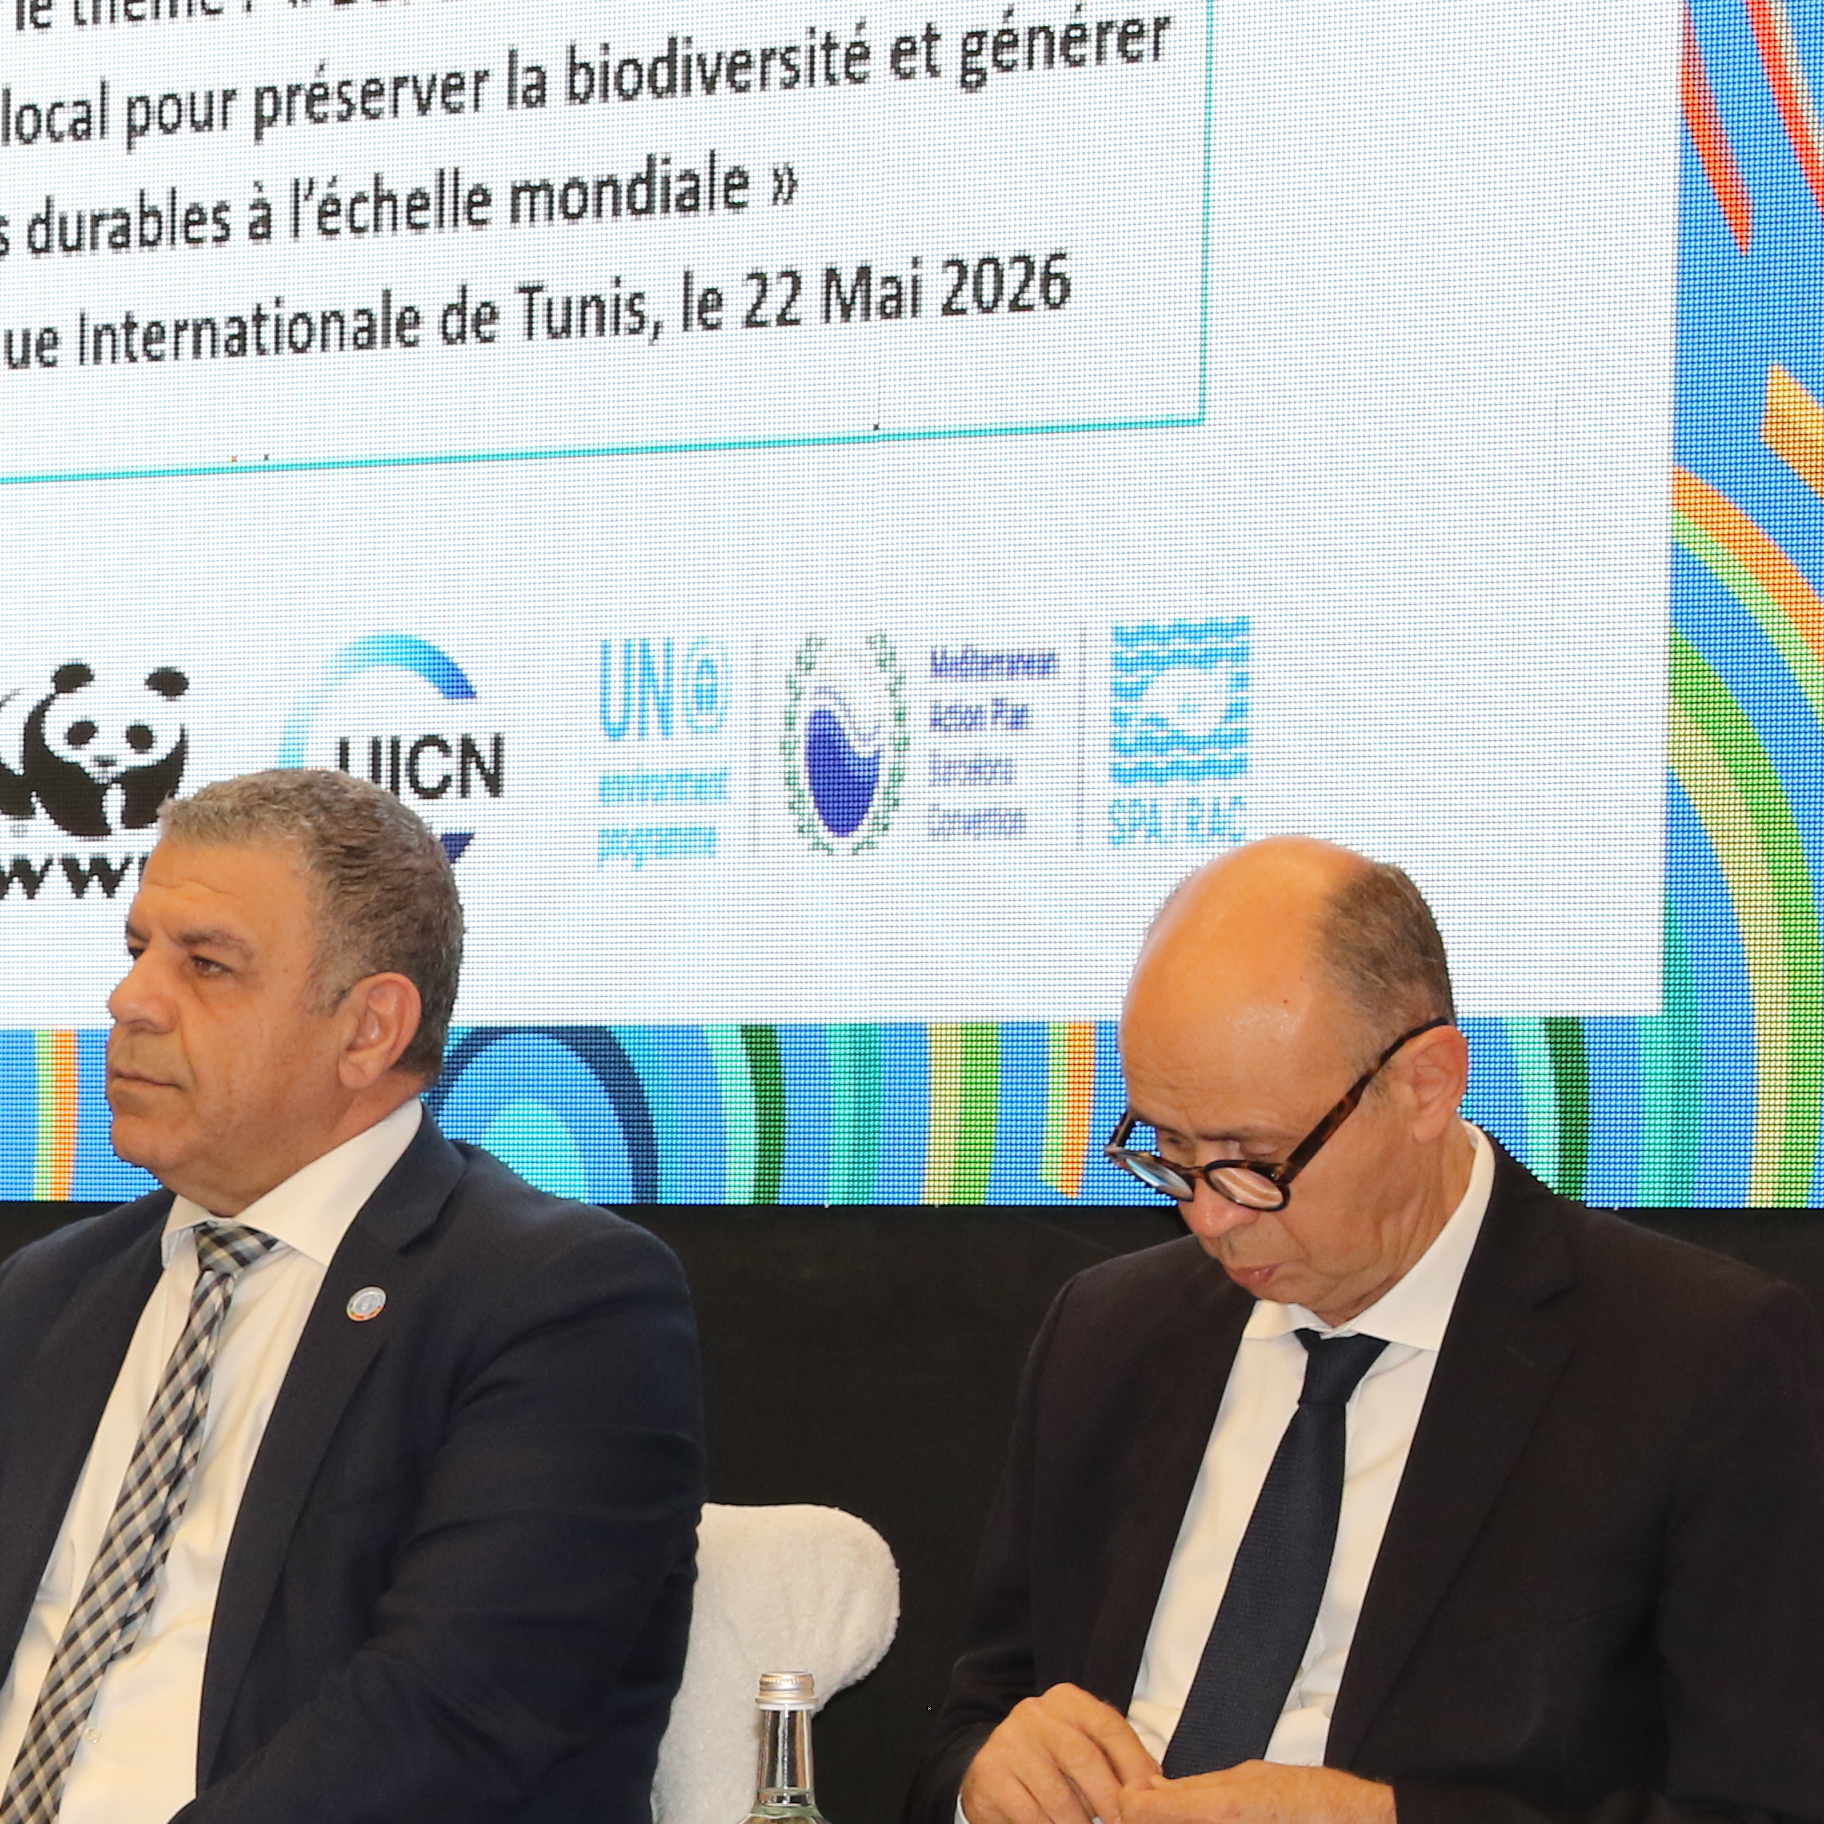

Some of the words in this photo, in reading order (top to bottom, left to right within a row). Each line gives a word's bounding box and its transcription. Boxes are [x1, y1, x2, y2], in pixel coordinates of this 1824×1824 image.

[1, 78, 109, 146] local
[125, 87, 238, 154] pour
[253, 59, 491, 145] préserver
[506, 47, 548, 110] la
[566, 18, 872, 106] biodiversité
[888, 21, 943, 82] et
[958, 1, 1173, 94] générer
[25, 186, 232, 257] durables
[247, 179, 274, 243] à
[291, 166, 493, 240] l’échelle
[509, 148, 751, 225] mondiale
[771, 163, 799, 207] »
[77, 287, 423, 366] Internationale
[439, 283, 501, 347] de
[516, 275, 663, 346] Tunis,
[681, 269, 725, 333] le
[742, 268, 803, 330] 22
[822, 255, 922, 325] Mai
[940, 250, 1073, 318] 2026
[599, 638, 674, 742] UN
[930, 700, 985, 732] Action
[991, 697, 1031, 731] Plan
